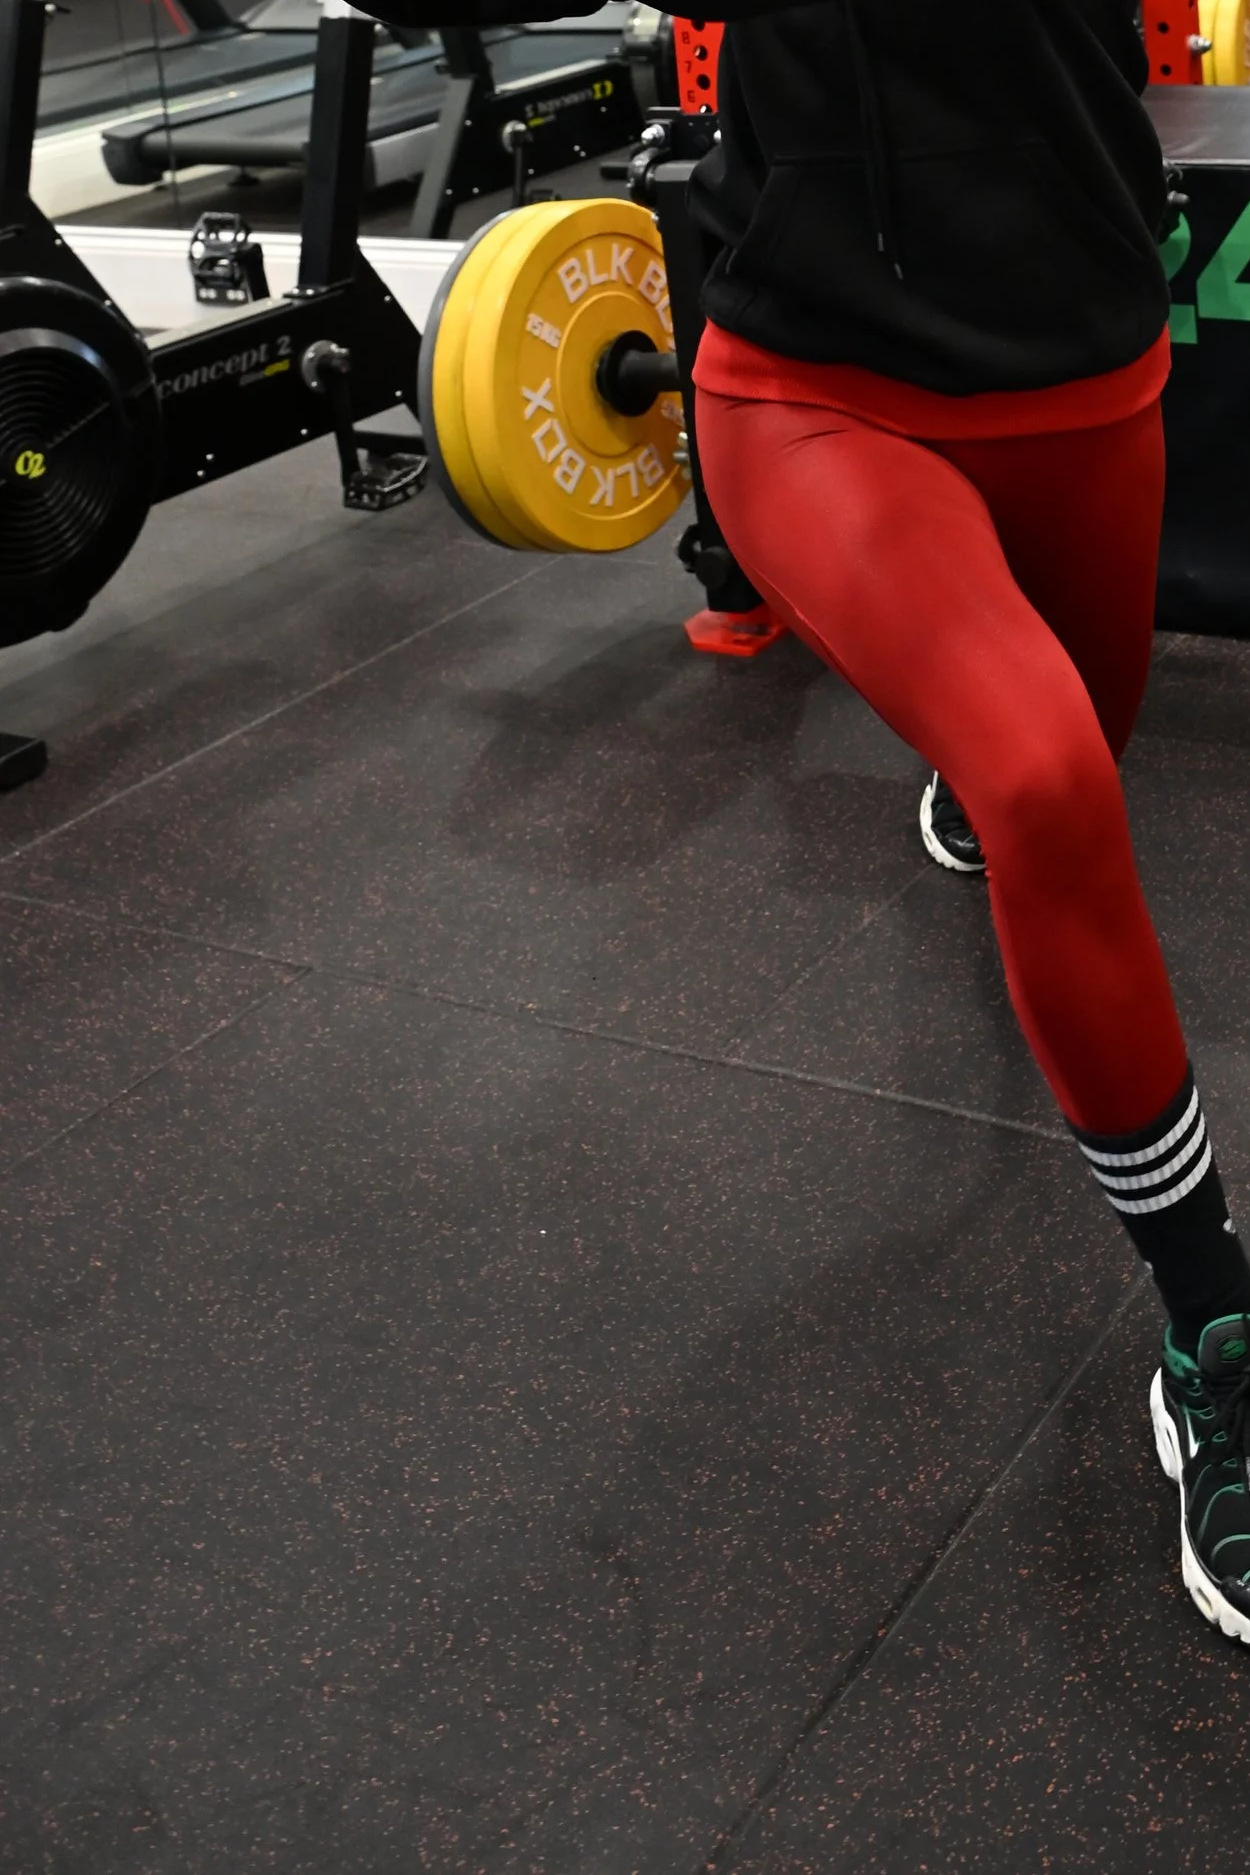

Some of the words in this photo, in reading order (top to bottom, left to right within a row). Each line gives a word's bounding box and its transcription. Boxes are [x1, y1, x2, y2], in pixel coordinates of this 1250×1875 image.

[684, 60, 692, 74] 7
[557, 242, 634, 304] BLK
[276, 334, 292, 357] 2
[521, 377, 586, 494] BOX
[590, 442, 665, 507] BLK
